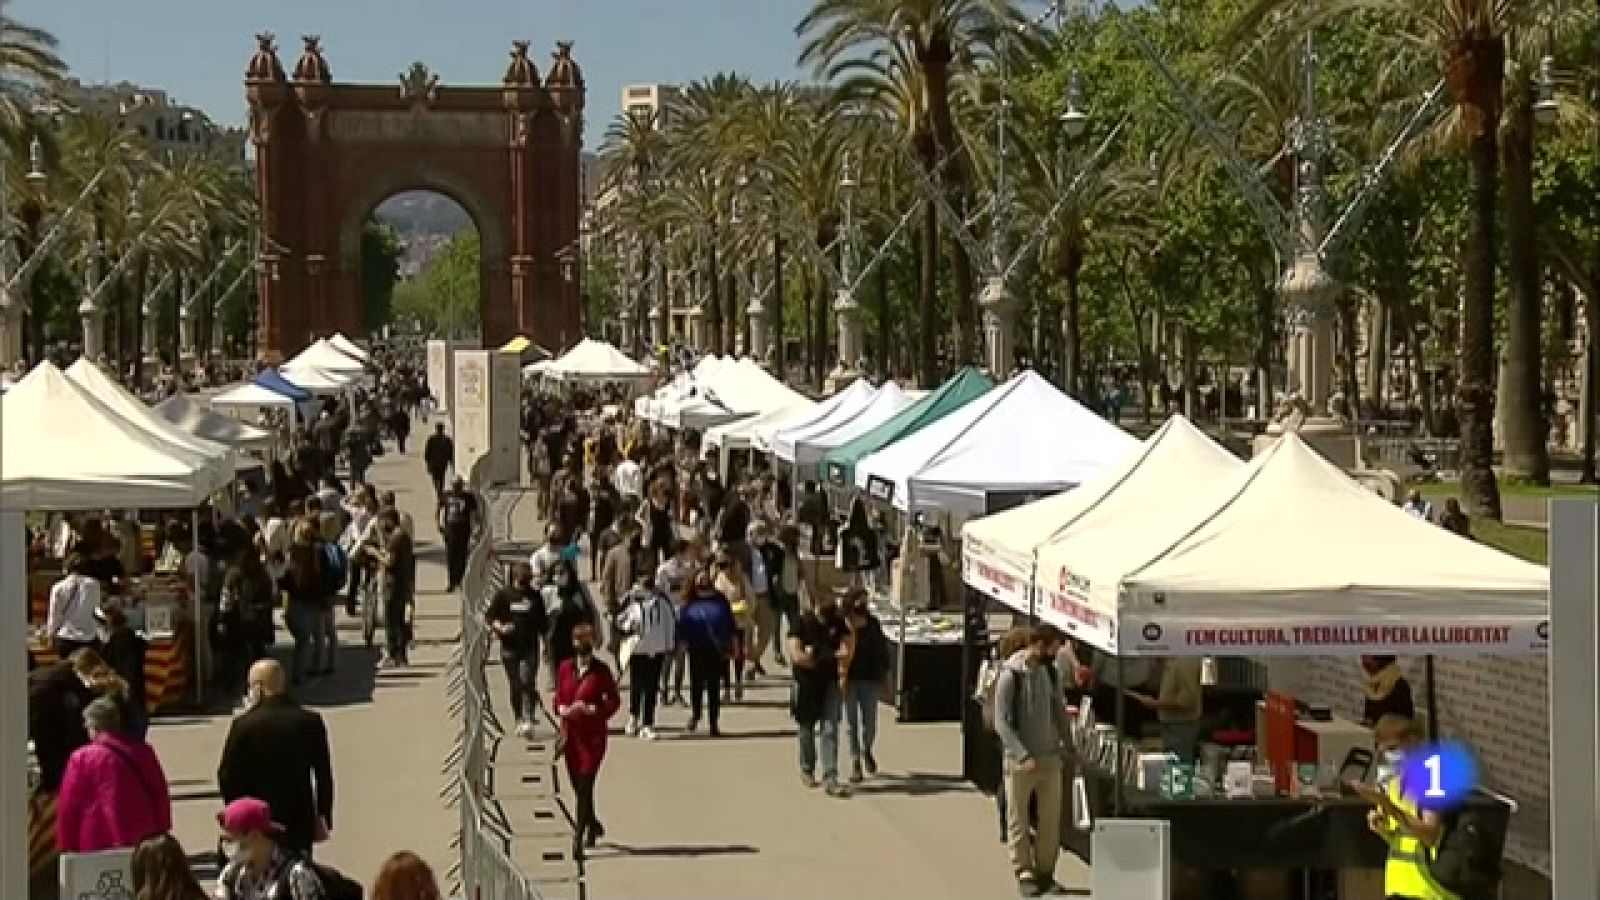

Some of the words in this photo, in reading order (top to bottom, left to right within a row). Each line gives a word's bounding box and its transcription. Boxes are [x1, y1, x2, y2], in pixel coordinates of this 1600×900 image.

[1186, 628, 1216, 645] FEM
[1219, 627, 1290, 646] CULTURA,
[1293, 625, 1379, 645] TREBALLEM
[1382, 625, 1411, 644] PER
[1412, 625, 1430, 644] LA
[1431, 624, 1511, 644] LLIBERTAT
